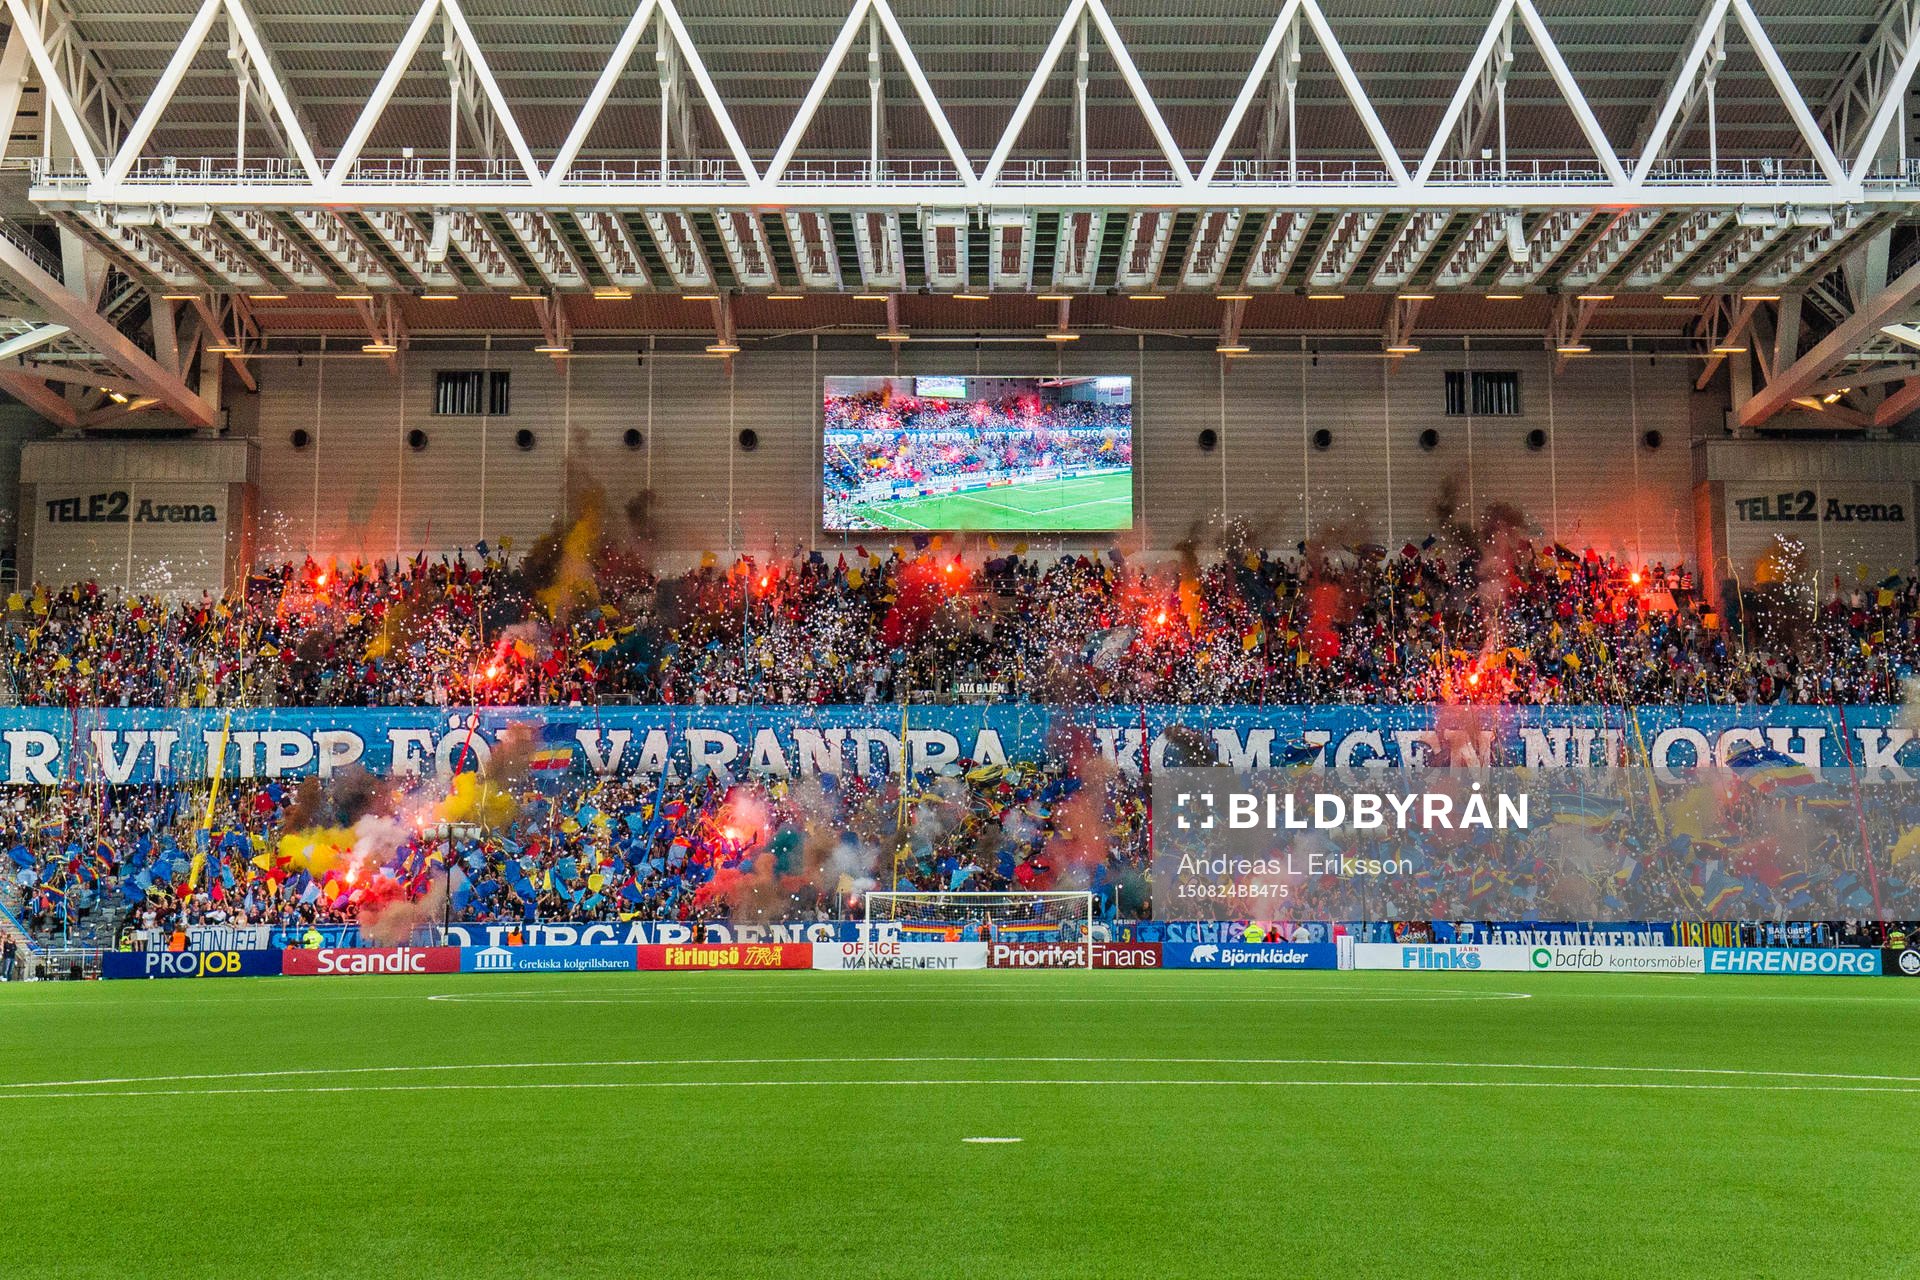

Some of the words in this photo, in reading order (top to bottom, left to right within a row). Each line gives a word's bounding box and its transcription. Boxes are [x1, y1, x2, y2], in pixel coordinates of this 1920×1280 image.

[46, 491, 129, 522] TELE2
[135, 499, 217, 522] Arena
[1735, 490, 1817, 521] TELE2
[1823, 499, 1905, 522] Arena
[956, 682, 975, 693] ATA
[3, 730, 61, 784] R
[91, 730, 178, 784] VI
[389, 713, 535, 779] FÖ
[575, 728, 1010, 783] VARANDRA
[1520, 728, 1624, 781] NU
[1652, 727, 1826, 784] OCH
[145, 952, 242, 977] PROJOB
[317, 947, 426, 973] Scandic
[519, 959, 561, 969] Grekiska
[564, 957, 629, 970] kolgrillsbaren
[665, 947, 740, 966] Färingsö
[743, 946, 783, 966] TRÄ
[842, 956, 958, 969] MANAGEMENT
[993, 945, 1085, 966] Prioritet
[1091, 945, 1156, 966] Finans
[1221, 949, 1309, 966] Björnkläder
[1402, 947, 1482, 969] Flinks
[1555, 948, 1604, 968] bafab
[1609, 953, 1702, 968] kontorsmöbler
[1710, 951, 1876, 973] EHRENBORG
